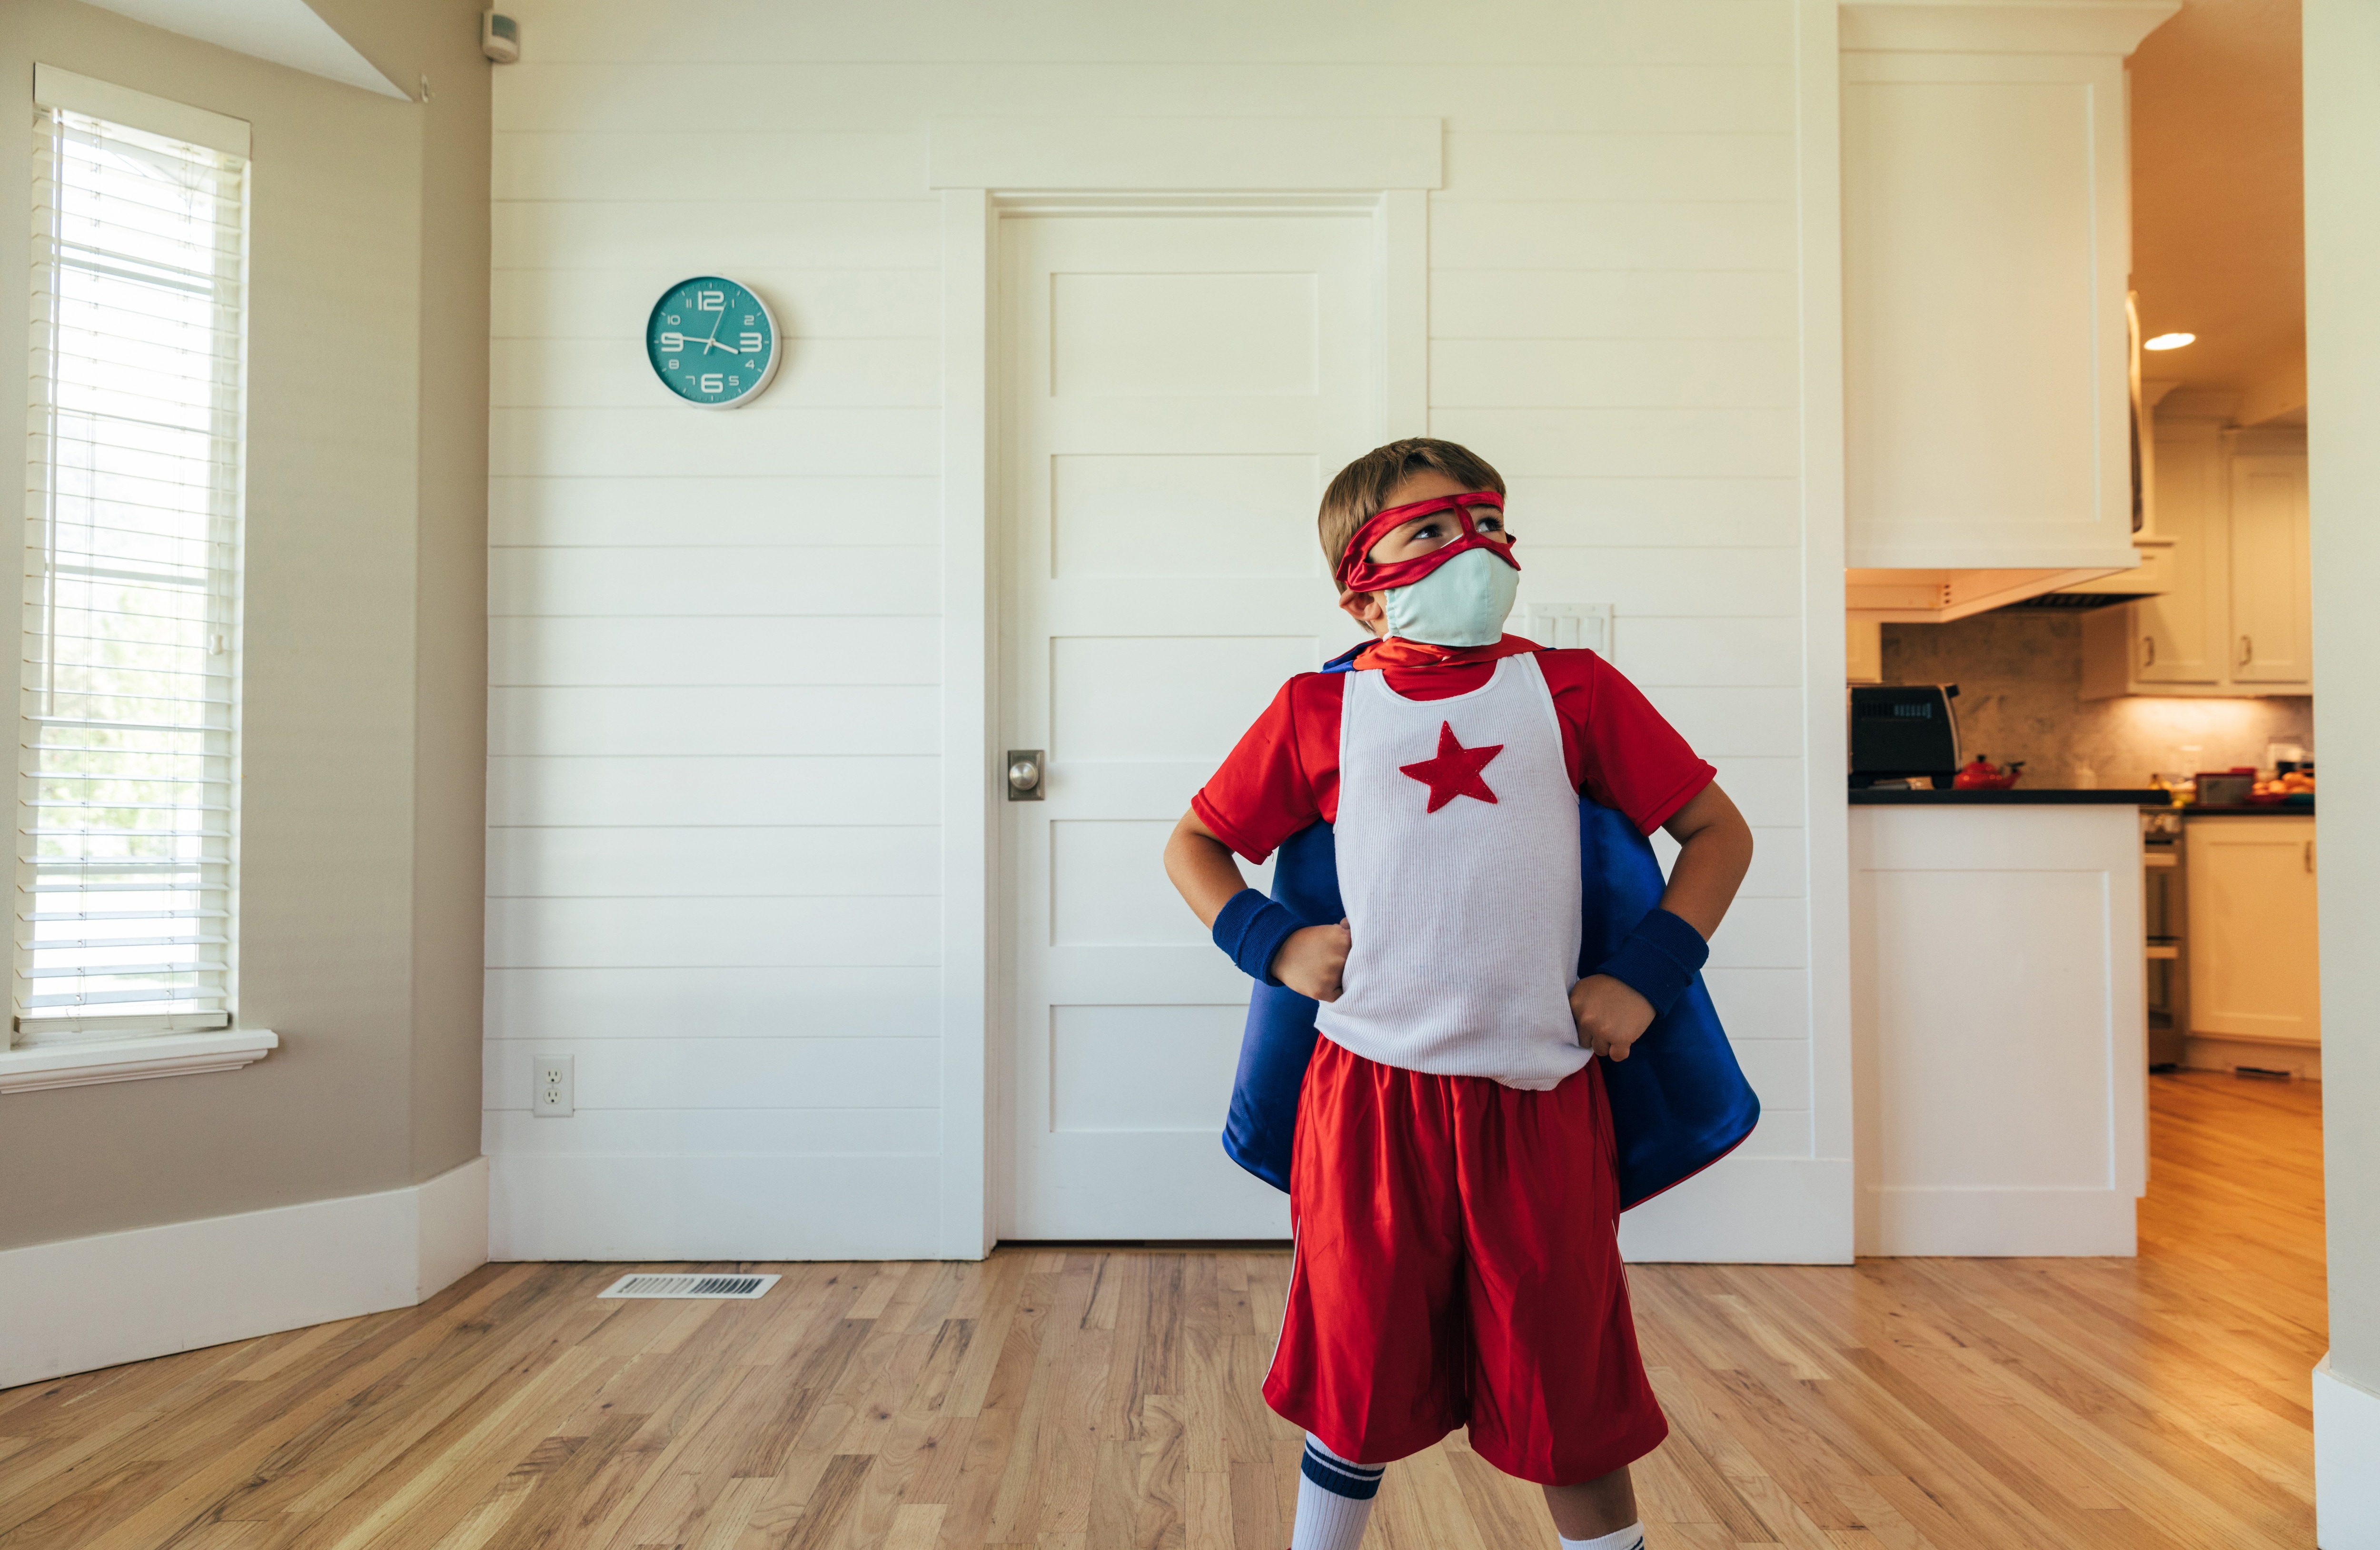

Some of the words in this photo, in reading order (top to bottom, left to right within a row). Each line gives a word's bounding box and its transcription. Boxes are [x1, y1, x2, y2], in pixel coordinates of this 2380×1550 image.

[686, 299, 692, 308] 11
[698, 291, 724, 311] 12
[732, 299, 734, 308] 1
[667, 315, 681, 326] 10
[744, 316, 754, 326] 2
[661, 332, 684, 352] 9
[740, 333, 762, 352] 3
[669, 359, 679, 369] 8
[745, 360, 755, 369] 4
[685, 376, 695, 385] 7
[701, 374, 724, 393] 6
[729, 376, 739, 386] 5
